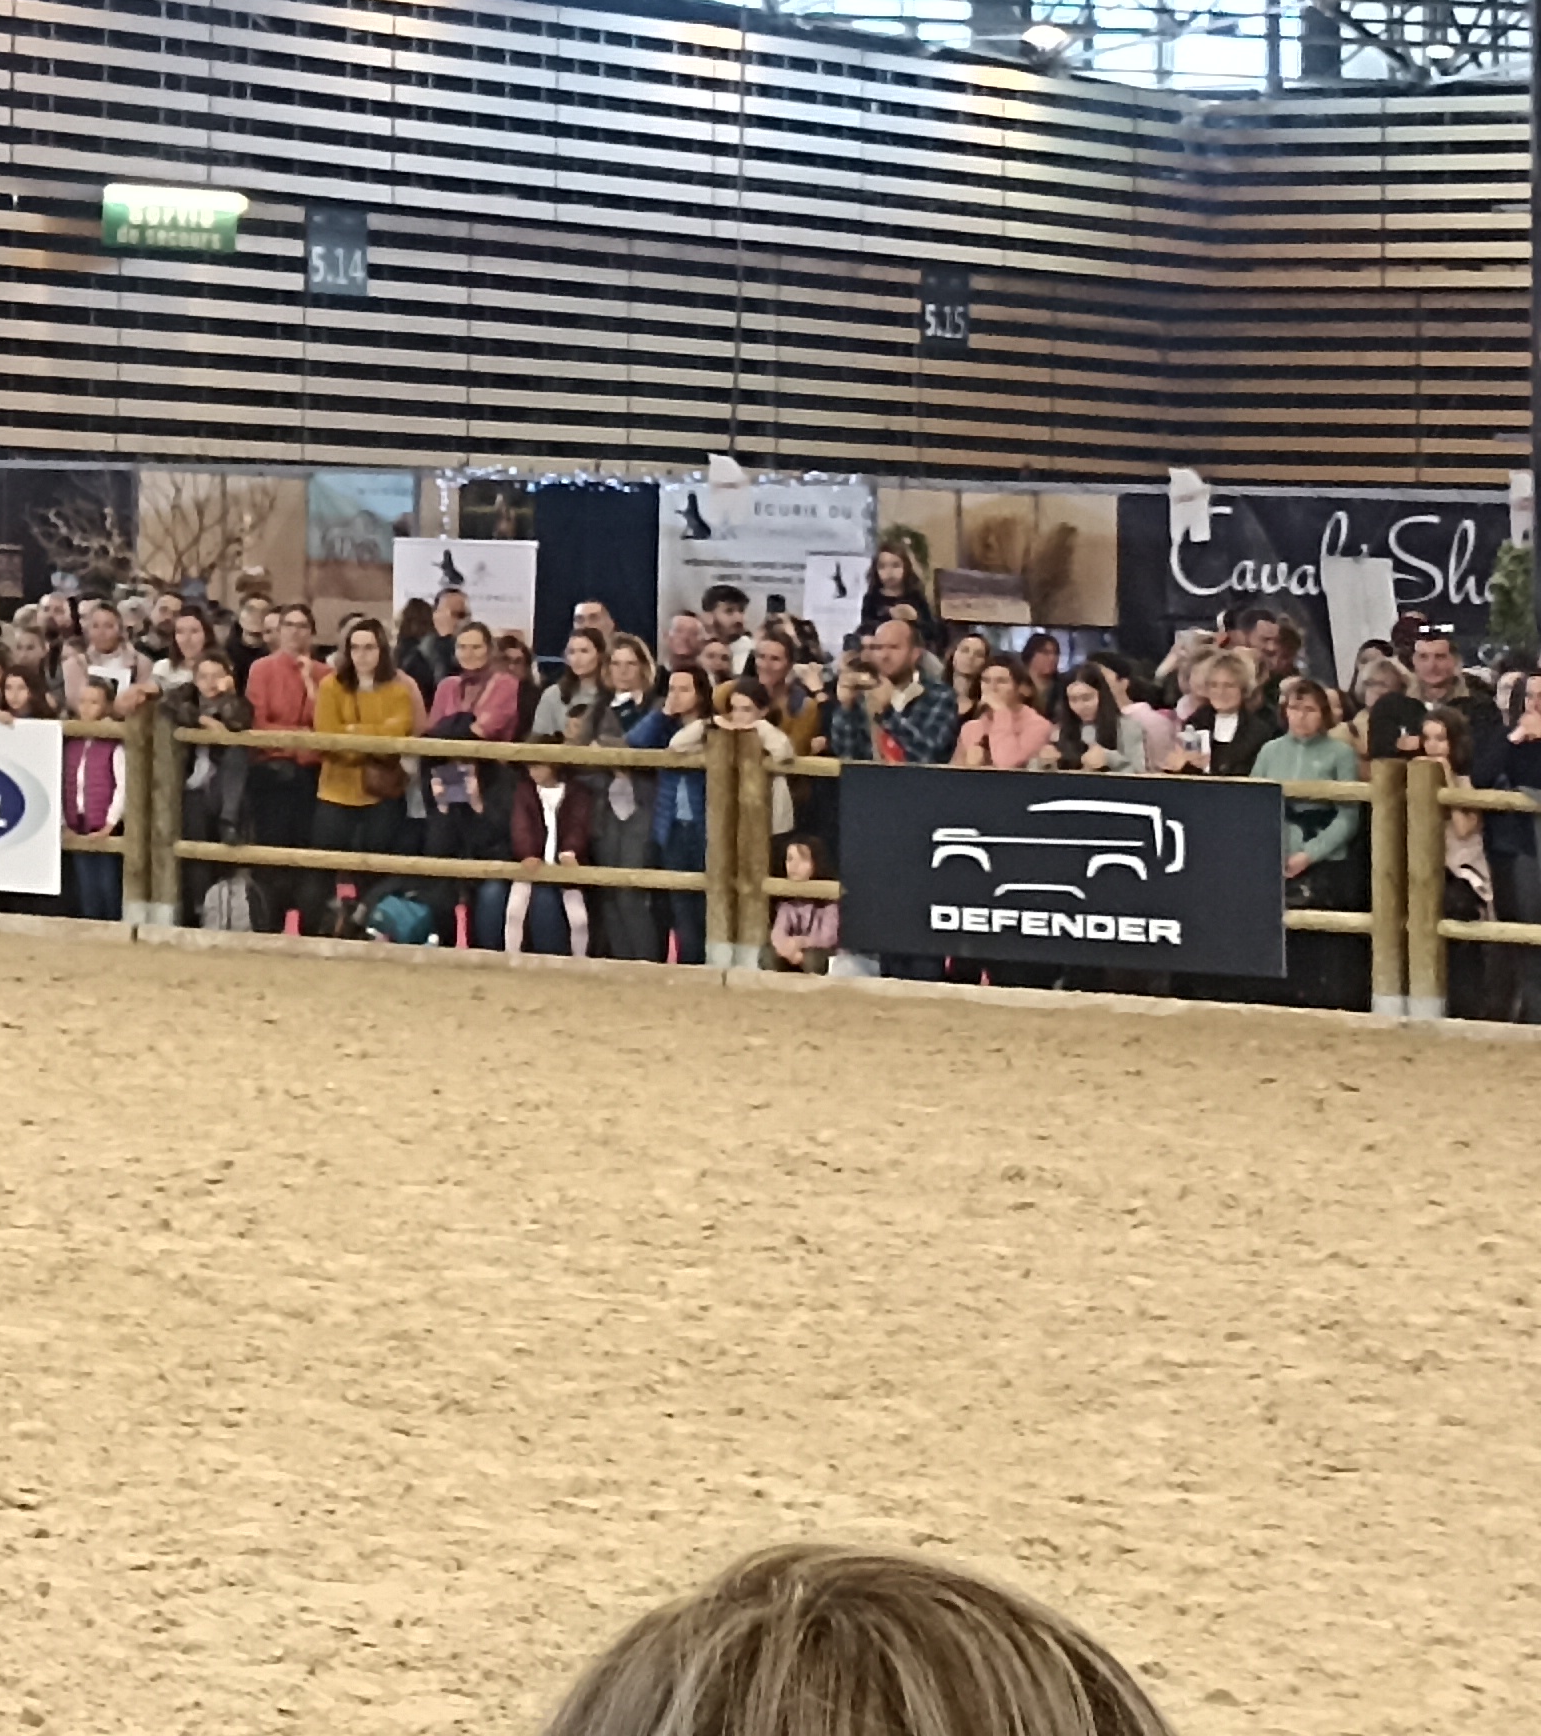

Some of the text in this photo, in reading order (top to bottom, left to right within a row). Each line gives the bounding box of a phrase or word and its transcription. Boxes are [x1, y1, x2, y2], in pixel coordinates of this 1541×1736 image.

[310, 246, 364, 286] 5.14
[924, 303, 966, 339] 5.15
[930, 904, 1182, 945] DEFENDER
